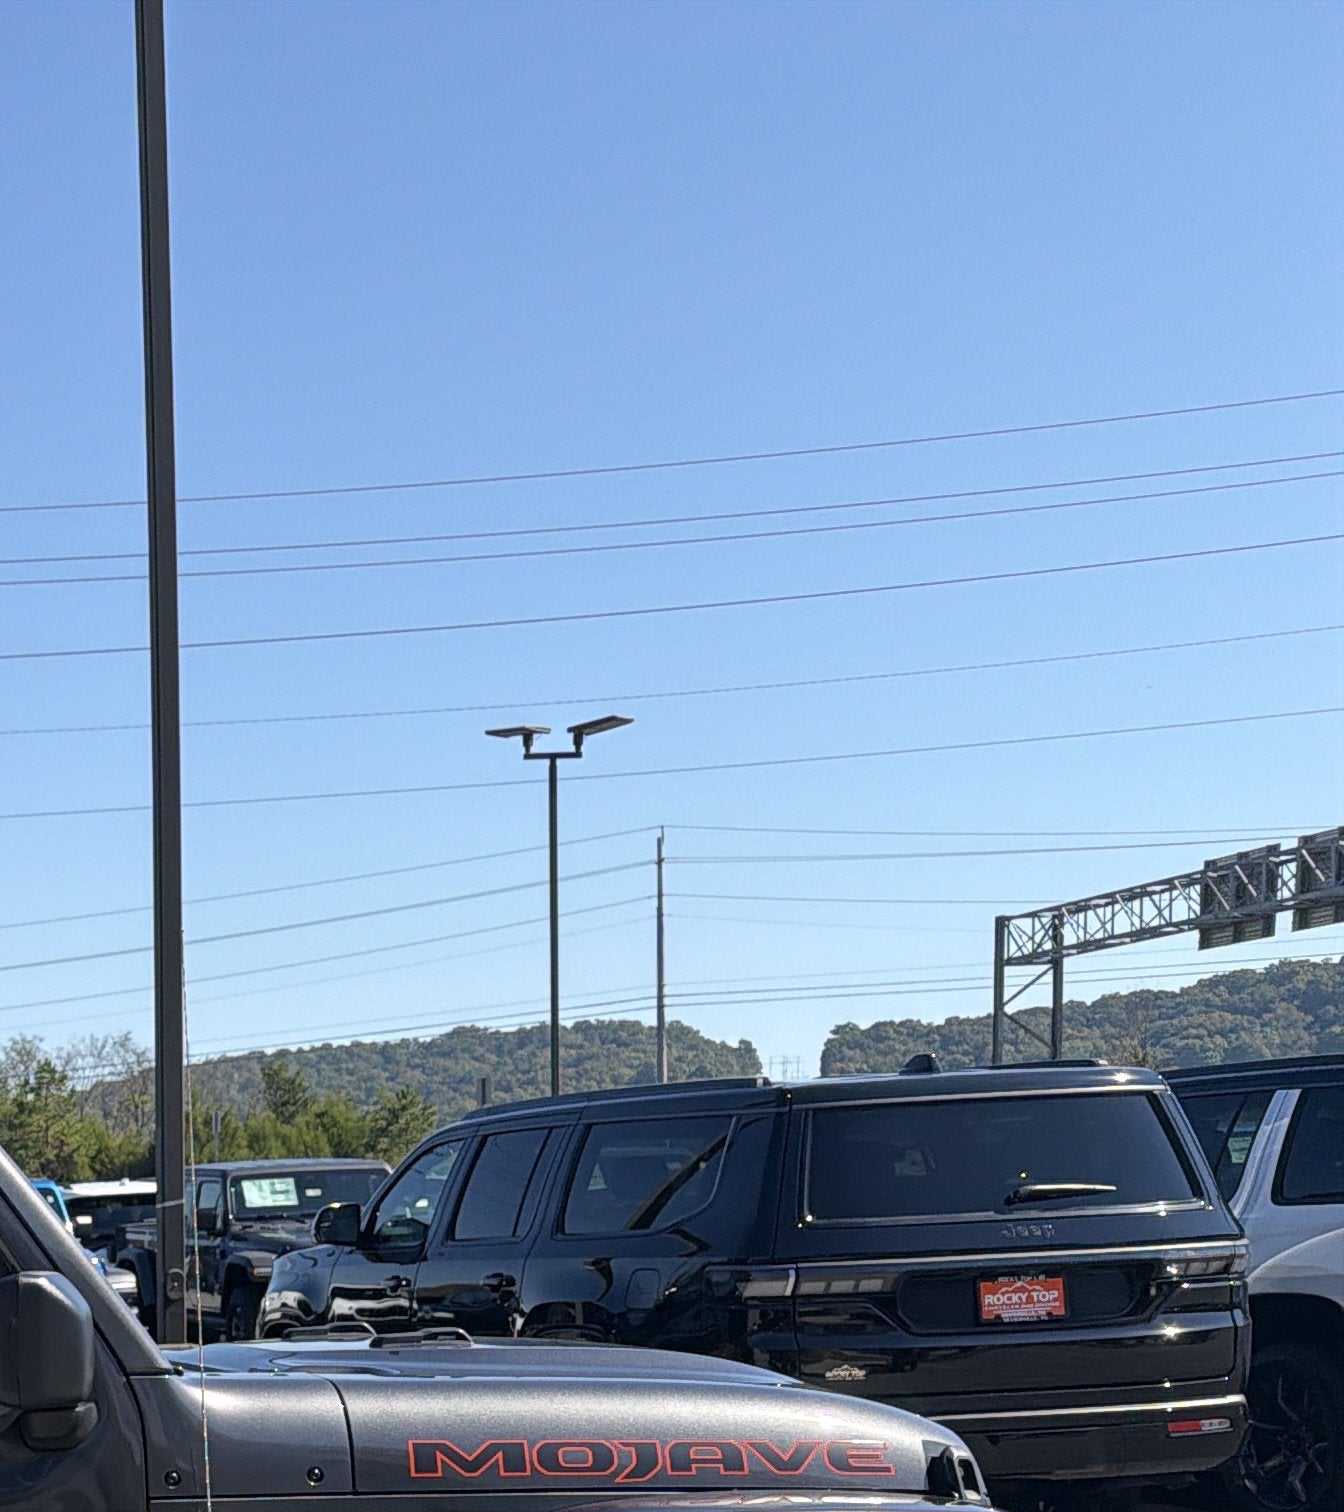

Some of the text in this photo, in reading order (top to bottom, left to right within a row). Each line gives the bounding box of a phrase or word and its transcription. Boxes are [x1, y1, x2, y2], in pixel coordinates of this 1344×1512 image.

[984, 1291, 1029, 1306] ROCKY
[1030, 1290, 1059, 1303] TOP
[408, 1439, 895, 1483] MOJAVE
